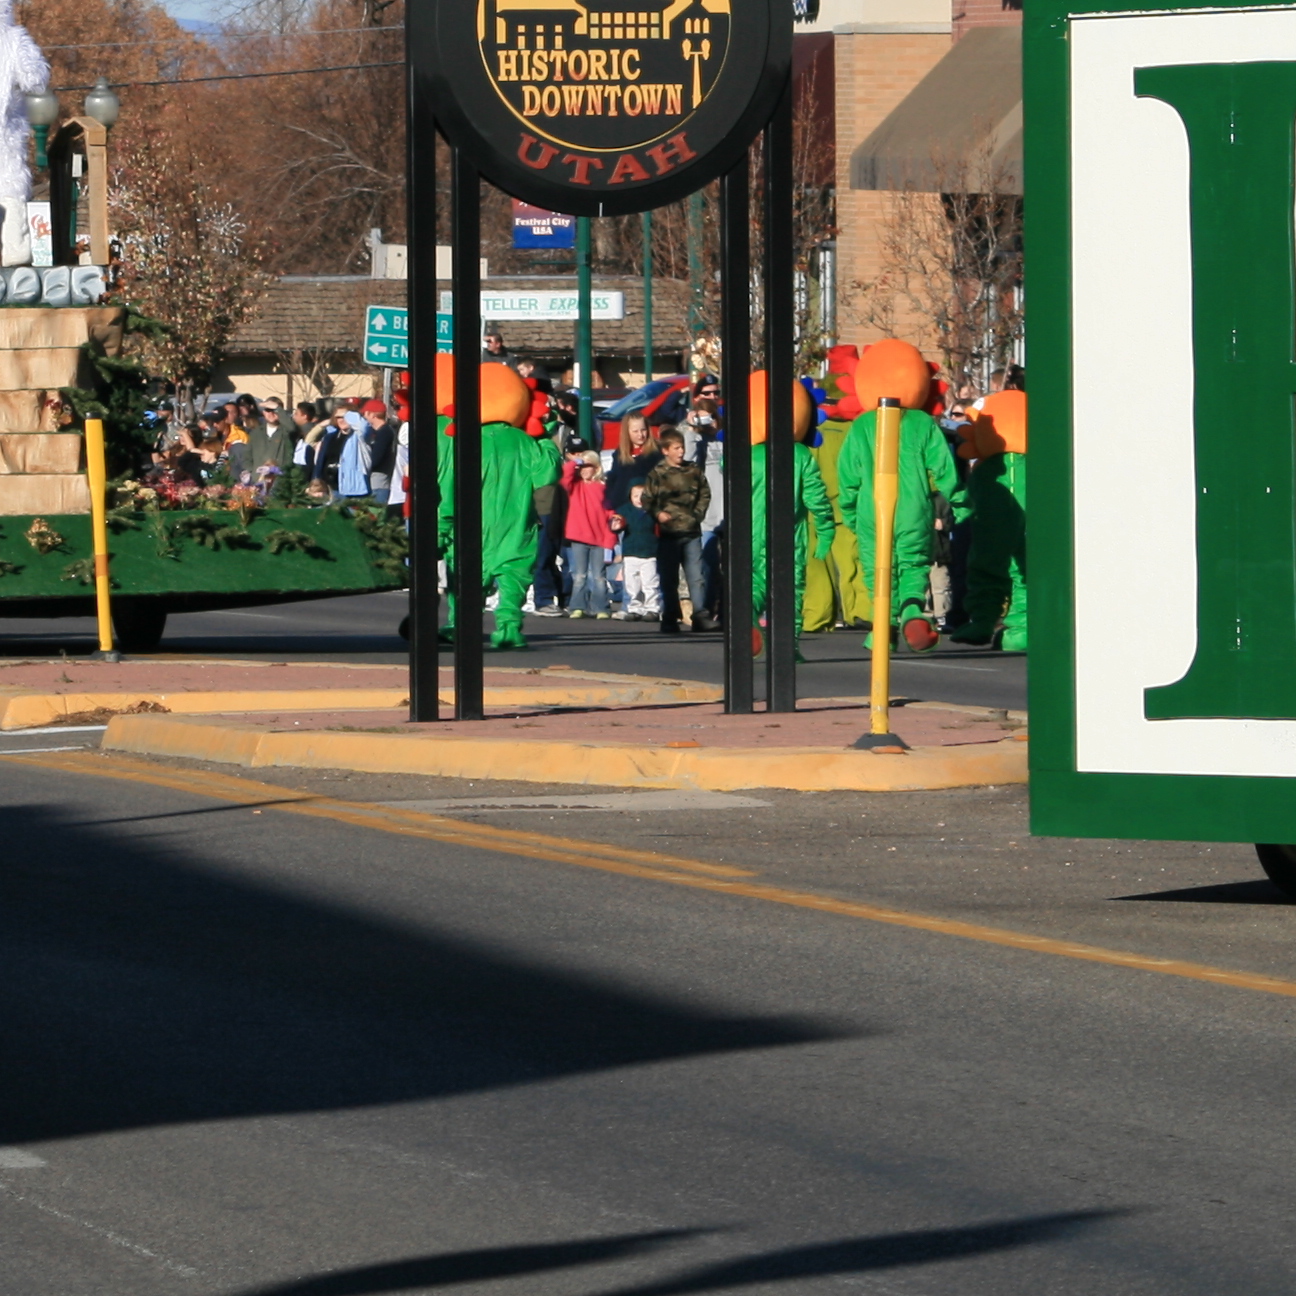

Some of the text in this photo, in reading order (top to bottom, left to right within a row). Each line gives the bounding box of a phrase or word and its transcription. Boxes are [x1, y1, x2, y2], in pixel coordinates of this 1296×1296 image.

[497, 49, 641, 82] HISTORIC
[521, 84, 683, 117] DOWNTOWN
[516, 131, 697, 185] UTAH
[515, 217, 571, 228] Festival City
[532, 226, 554, 235] USA
[482, 297, 609, 310] TELLER EXPSS
